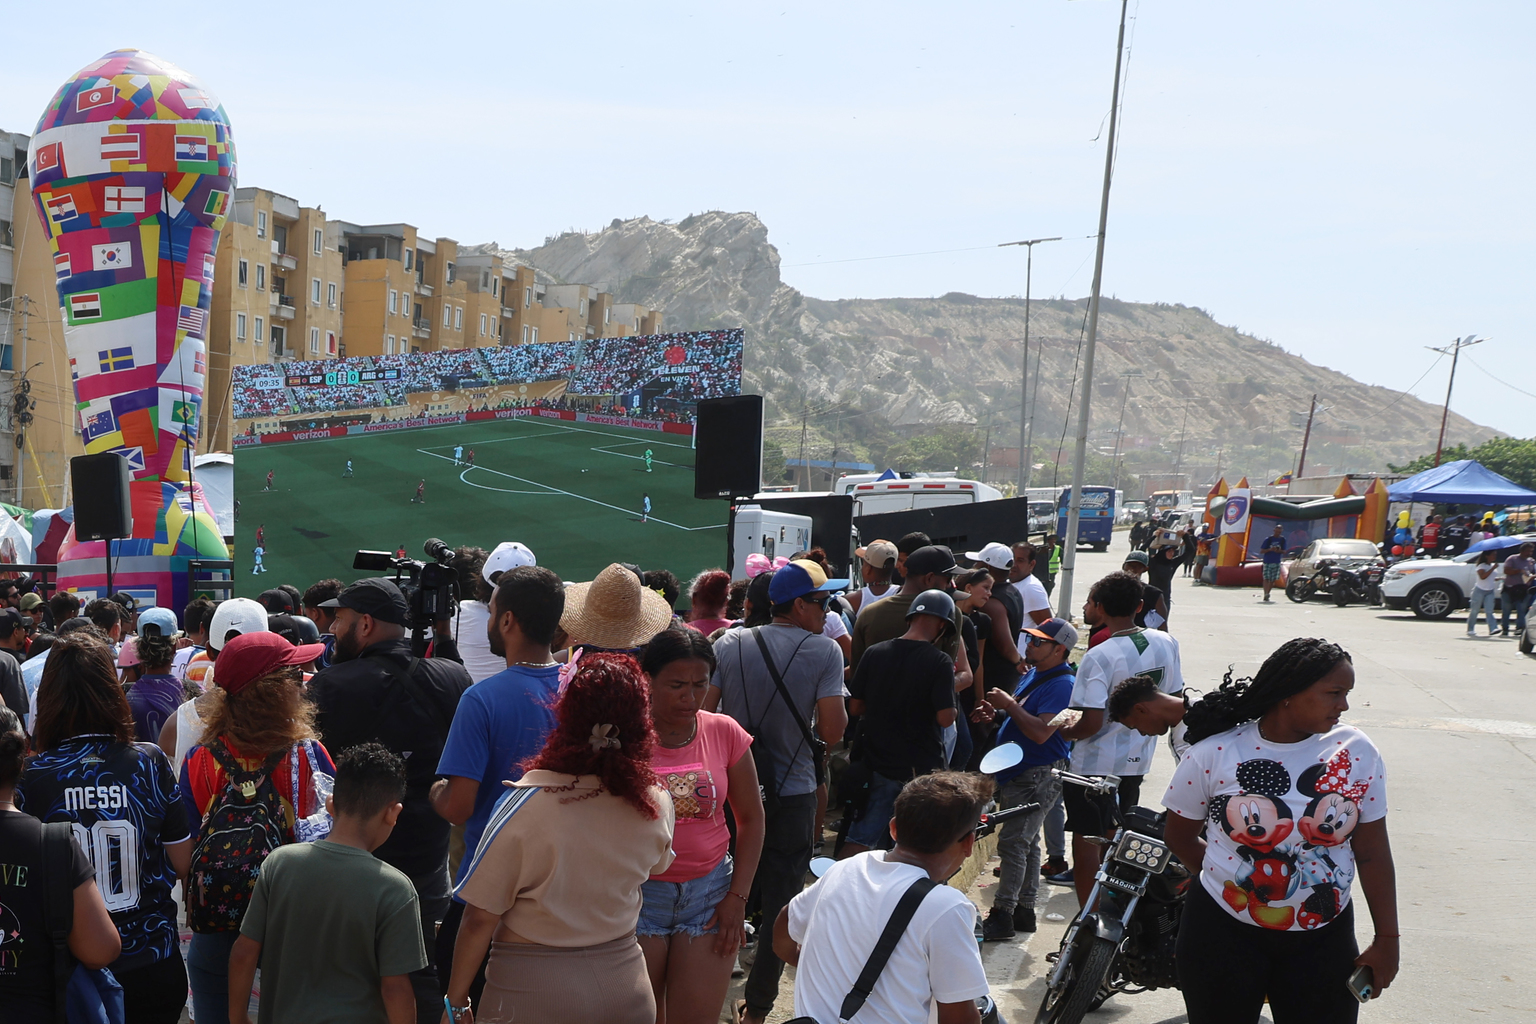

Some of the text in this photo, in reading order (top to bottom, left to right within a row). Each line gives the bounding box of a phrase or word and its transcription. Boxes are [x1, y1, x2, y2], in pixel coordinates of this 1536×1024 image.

[651, 365, 700, 375] TELEVEN
[259, 378, 280, 388] 09:35
[309, 376, 323, 384] ESP
[361, 372, 377, 380] ARG
[494, 407, 533, 419] verizon
[539, 409, 561, 419] verizon
[363, 414, 462, 432] America's Best Network
[586, 415, 659, 431] America's Best Network
[293, 429, 331, 441] verizon
[64, 785, 128, 811] MESSI
